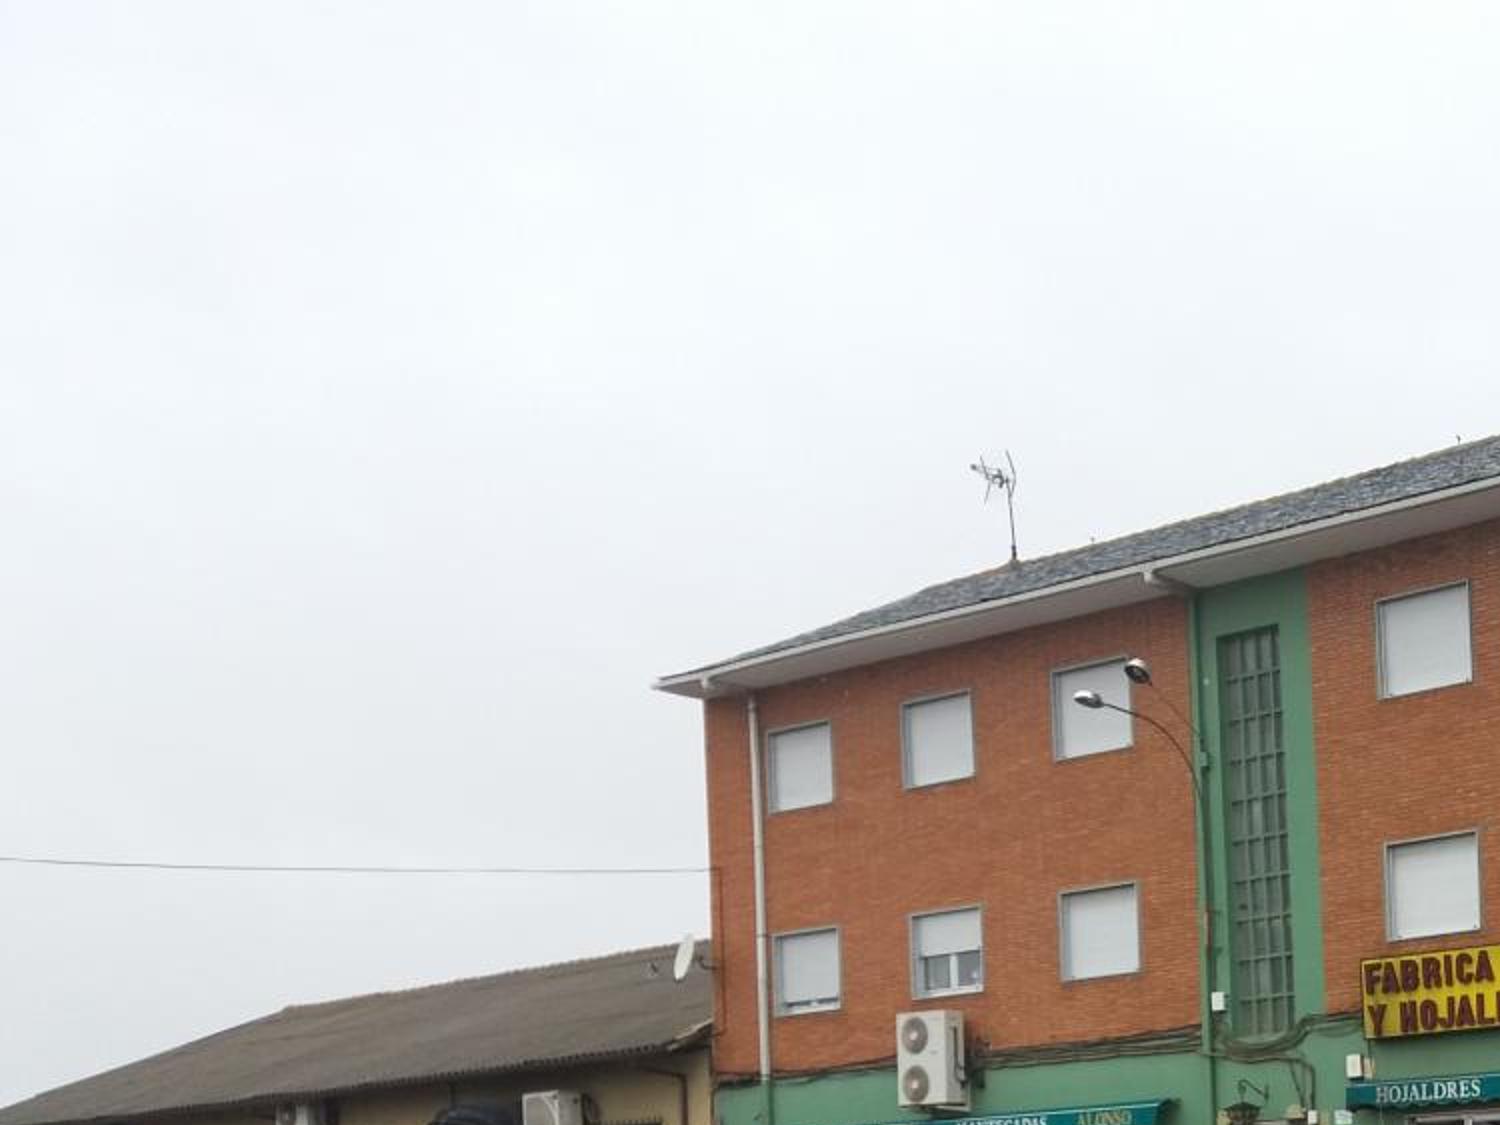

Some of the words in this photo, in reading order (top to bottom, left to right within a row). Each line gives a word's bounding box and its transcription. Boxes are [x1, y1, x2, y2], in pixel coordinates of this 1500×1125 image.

[1363, 949, 1496, 997] FABRICA
[1367, 1003, 1388, 1037] Y
[1375, 1079, 1482, 1104] HOJALDRES
